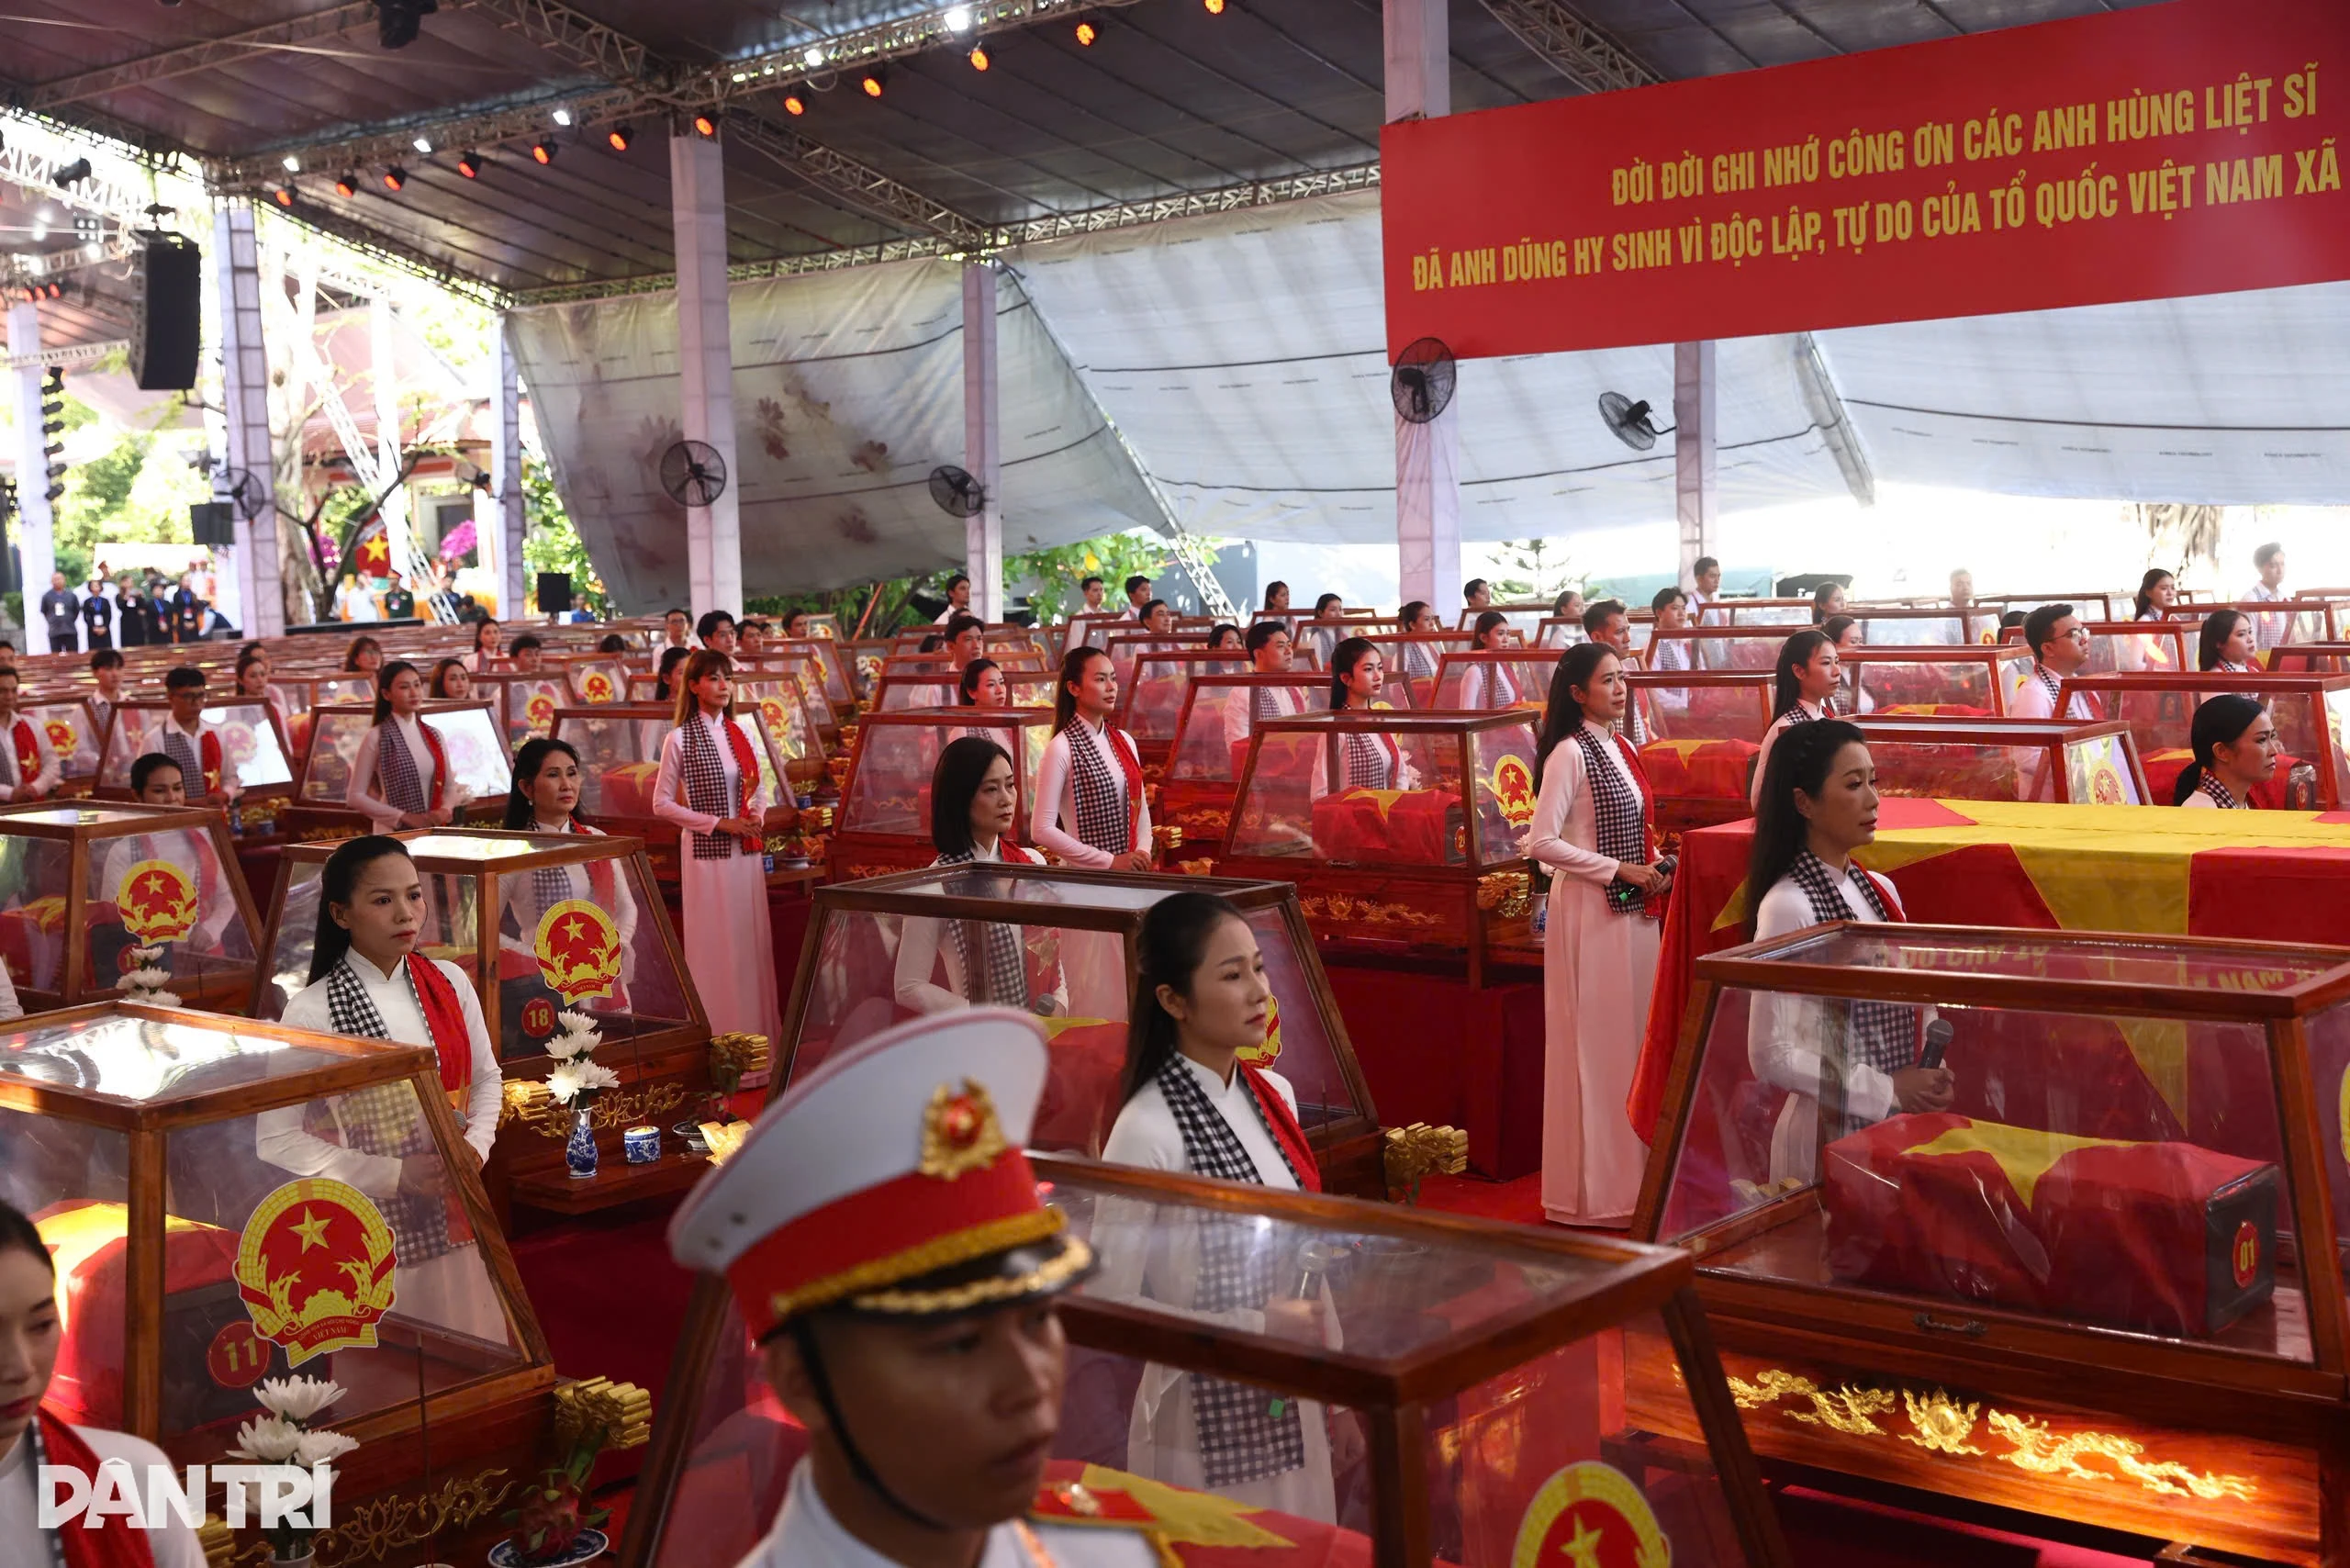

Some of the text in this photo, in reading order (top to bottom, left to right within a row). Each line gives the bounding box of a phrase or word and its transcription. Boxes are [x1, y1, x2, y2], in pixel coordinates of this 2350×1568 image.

[1611, 61, 2319, 206] ĐỜI ĐỜI GHI NHỚ CÔNG ƠN CÁC ANH HÙNG LIỆT SĨ
[1412, 137, 2342, 291] ĐÃ ANH DŨNG HY SINH VÌ ĐỘC LẬP, TỰ DO CỦA TỔ QUỐC VIỆT NAM XÃ
[528, 1007, 549, 1028] 18
[2240, 1238, 2255, 1271] 01
[223, 1336, 258, 1373] 11
